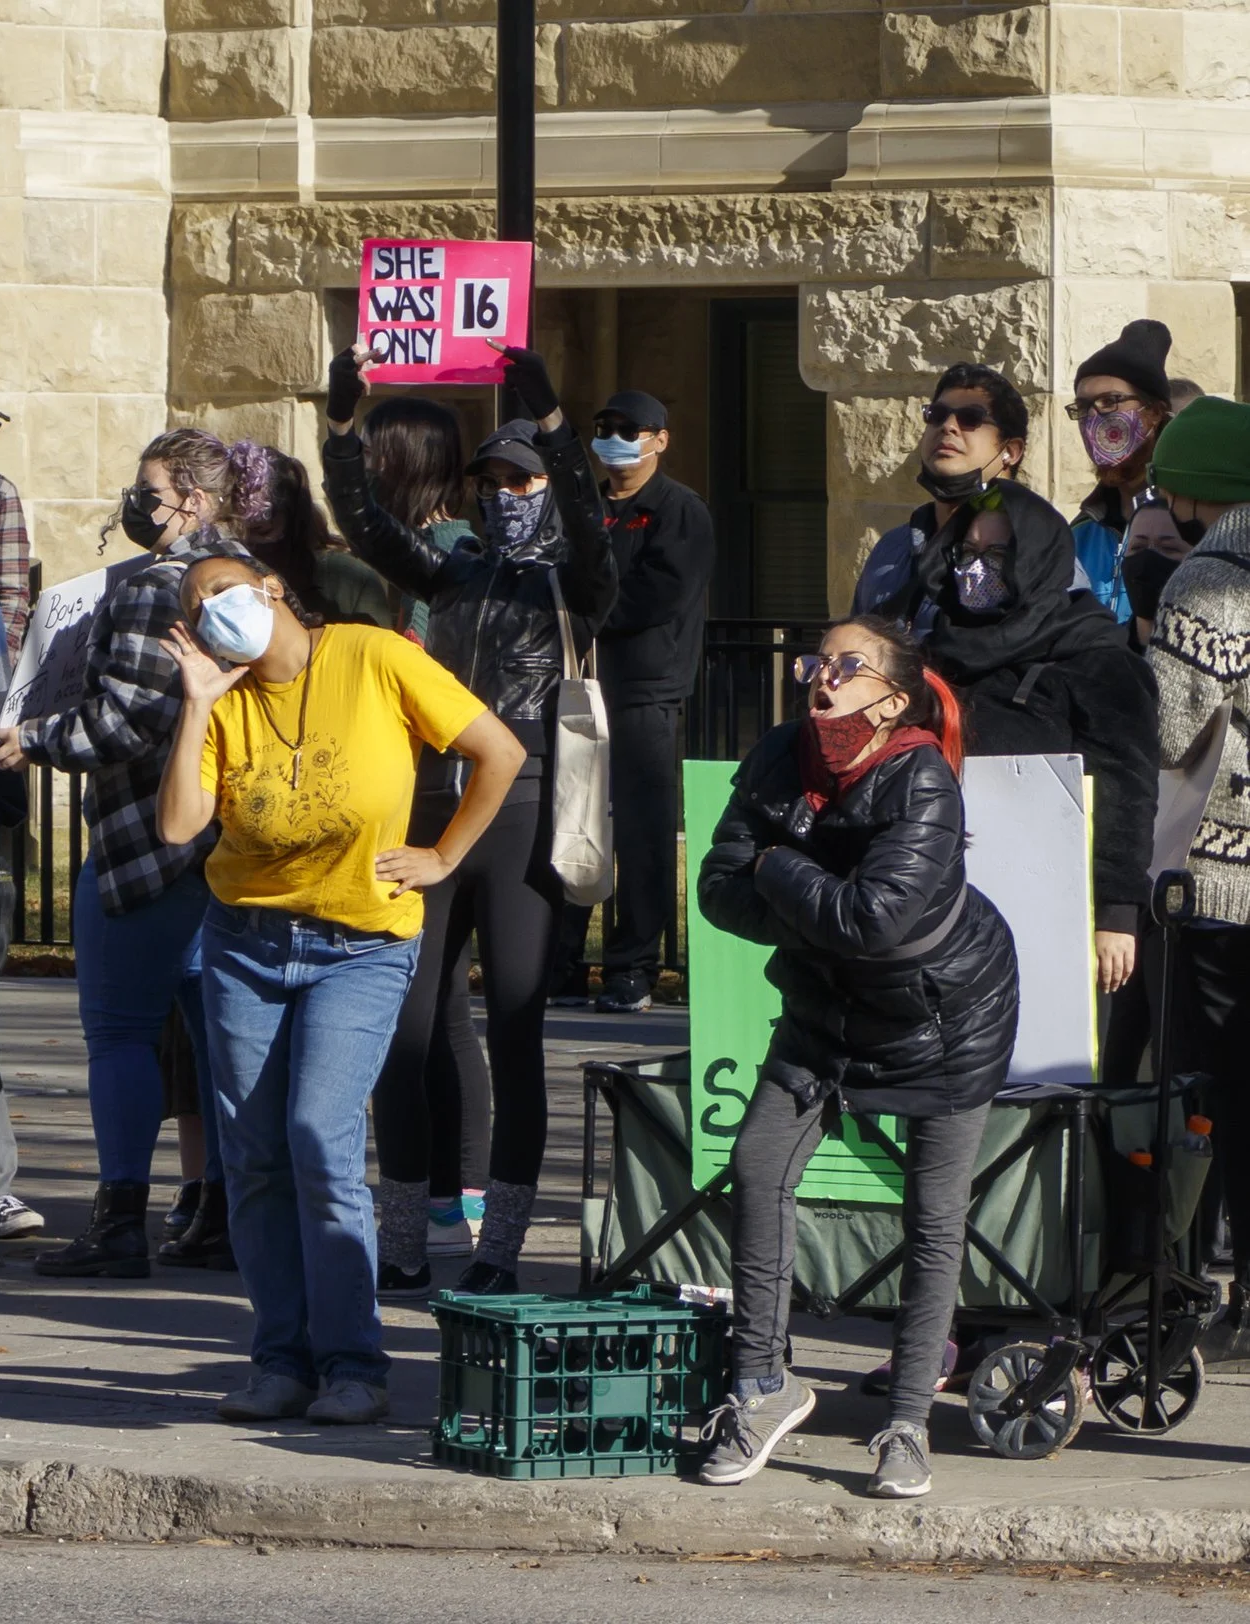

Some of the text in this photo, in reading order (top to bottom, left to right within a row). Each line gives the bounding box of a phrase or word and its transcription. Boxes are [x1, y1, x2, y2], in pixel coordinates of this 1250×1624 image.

[373, 247, 440, 281] SHE
[367, 286, 436, 322] WAS
[462, 282, 499, 330] 16
[369, 328, 437, 364] ONLY
[44, 593, 84, 632] Boys
